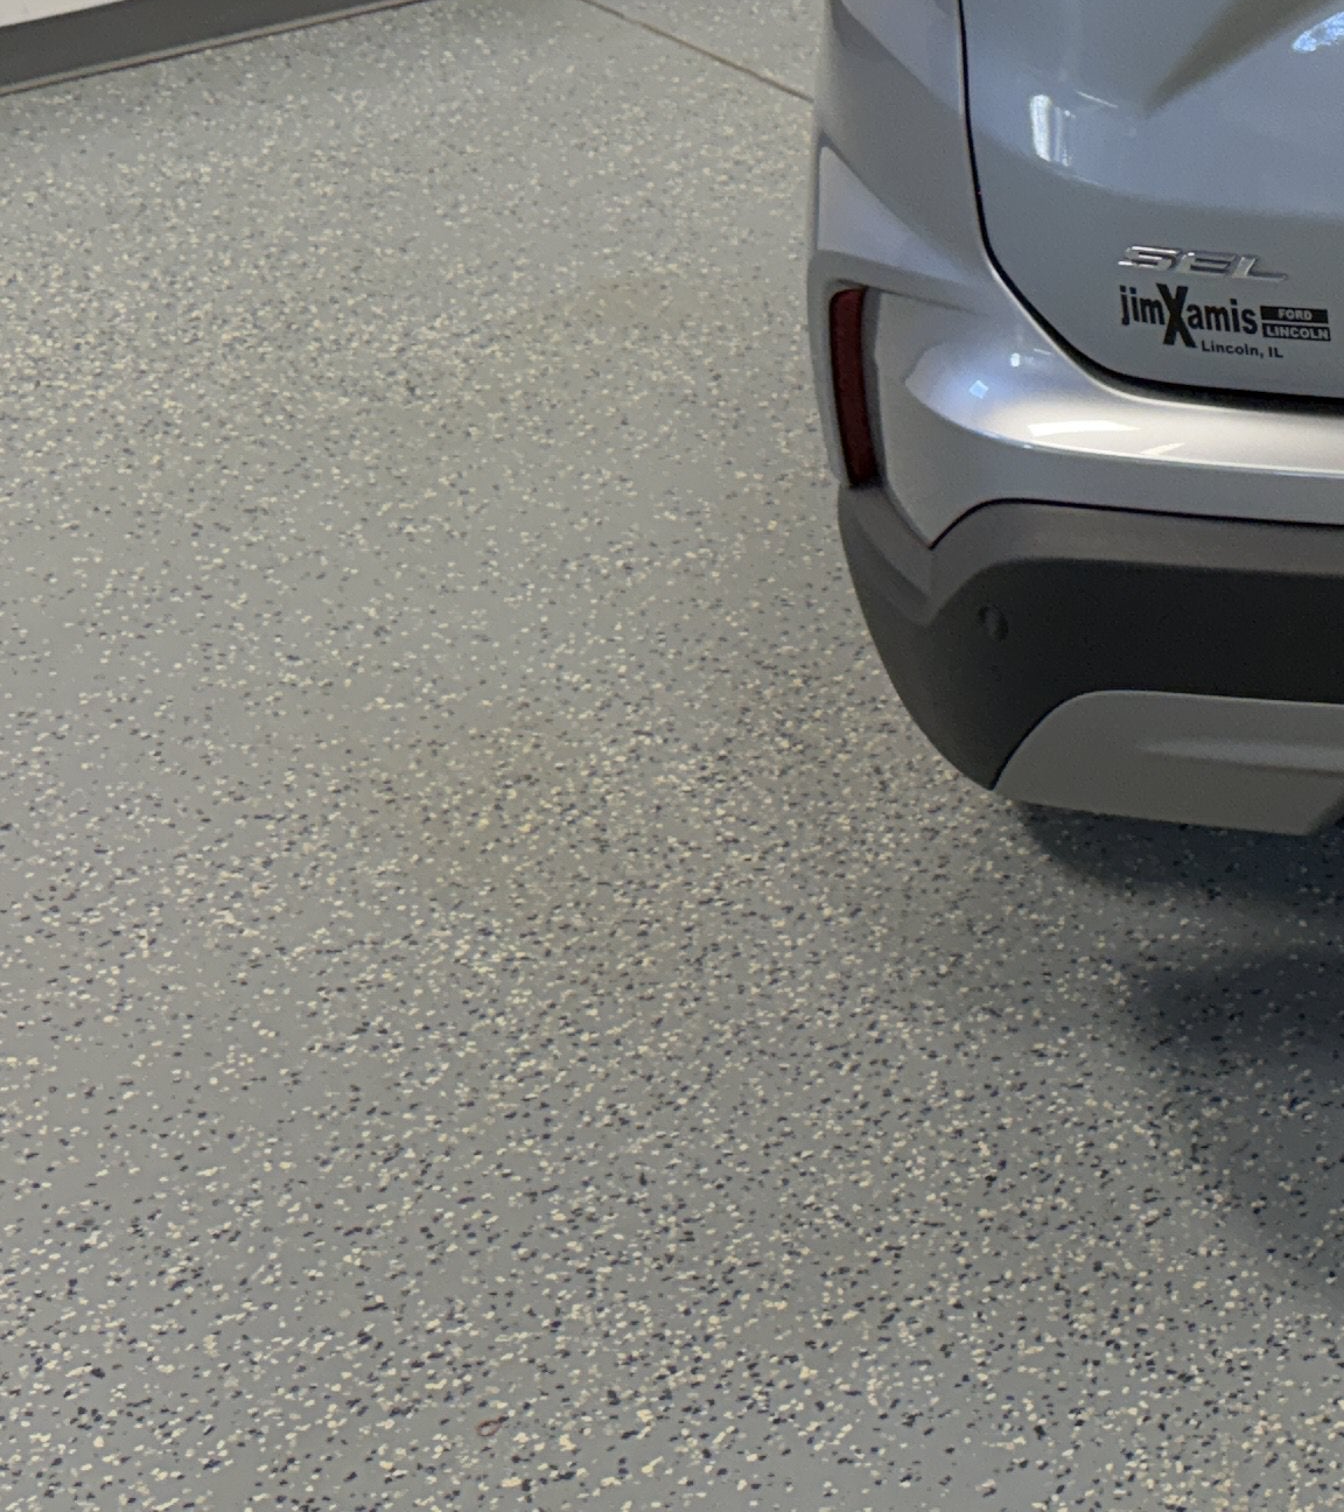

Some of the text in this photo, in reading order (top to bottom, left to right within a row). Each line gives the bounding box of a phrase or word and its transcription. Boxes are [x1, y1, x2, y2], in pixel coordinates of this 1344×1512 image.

[1118, 244, 1289, 281] SEL
[1277, 308, 1313, 322] FORD
[1265, 325, 1330, 340] LINCOLN
[1201, 340, 1284, 359] Lincoln, IL
